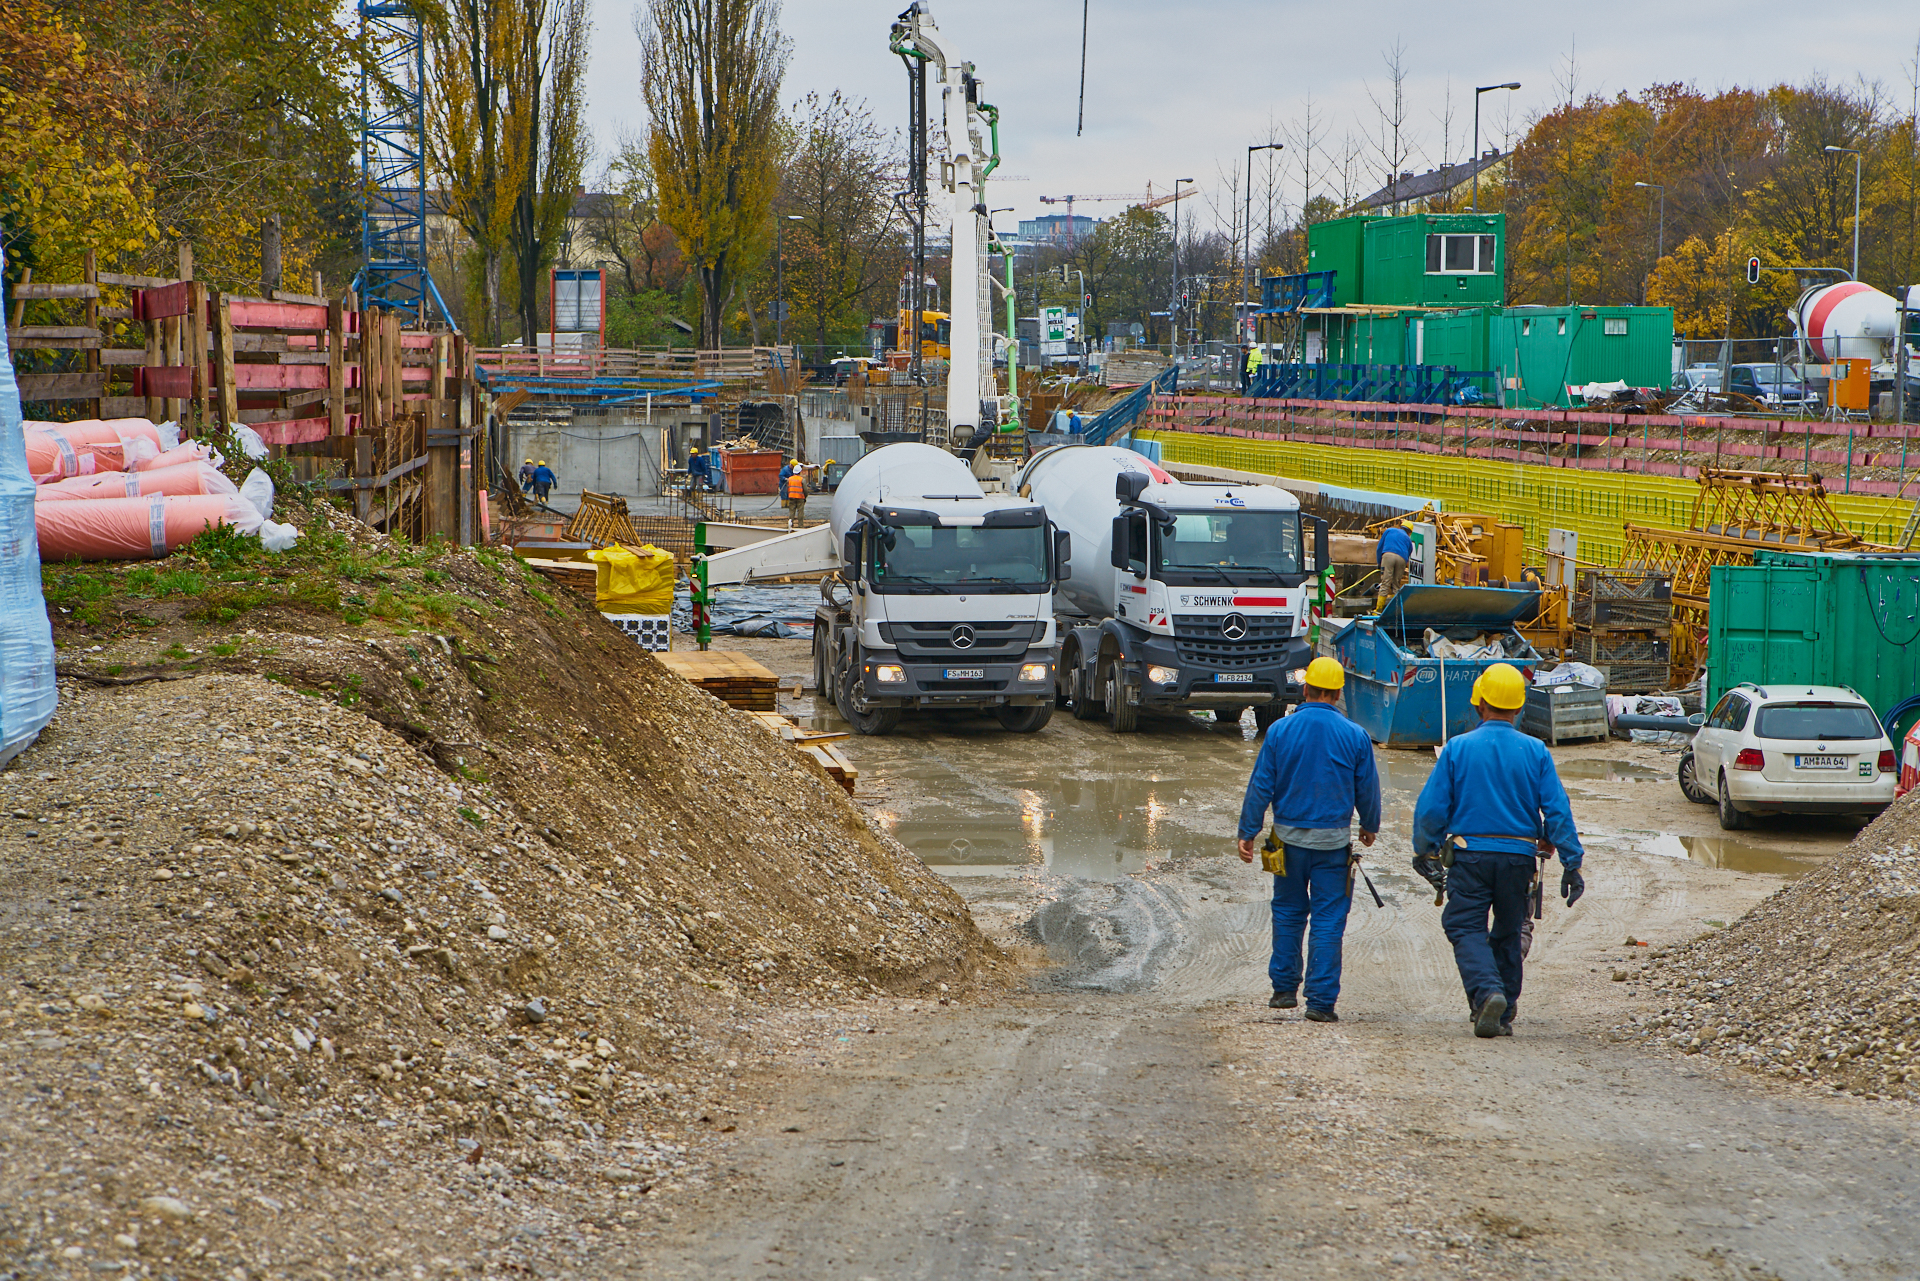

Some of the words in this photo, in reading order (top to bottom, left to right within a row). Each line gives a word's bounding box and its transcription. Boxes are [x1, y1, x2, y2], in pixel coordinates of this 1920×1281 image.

[1193, 595, 1234, 607] SCHWENK
[1150, 607, 1165, 615] 2134
[1218, 674, 1224, 682] M
[1236, 674, 1252, 682] 2134
[1803, 757, 1815, 766] AM
[1820, 757, 1832, 766] AA
[1833, 757, 1844, 766] 64
